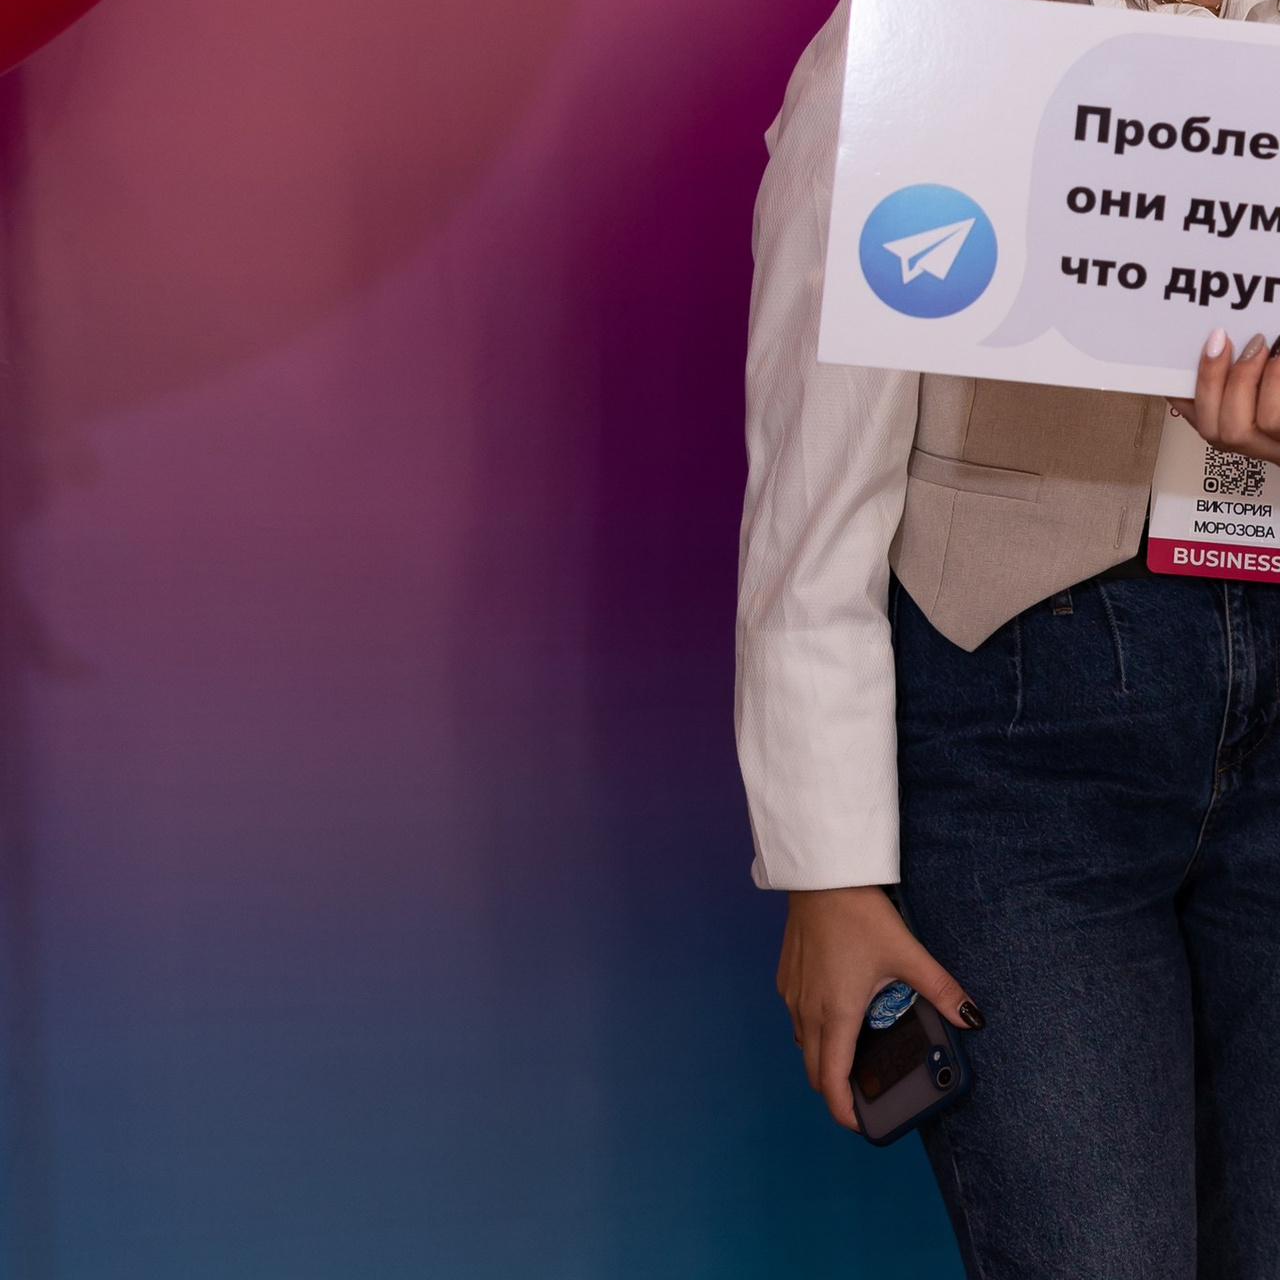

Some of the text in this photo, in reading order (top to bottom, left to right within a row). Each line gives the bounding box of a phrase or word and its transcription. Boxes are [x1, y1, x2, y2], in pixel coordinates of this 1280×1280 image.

[1066, 180, 1166, 222] они
[1061, 255, 1148, 290] что
[1196, 499, 1272, 518] ВИКТОРИЯ
[1193, 520, 1276, 539] МОРОЗОВА
